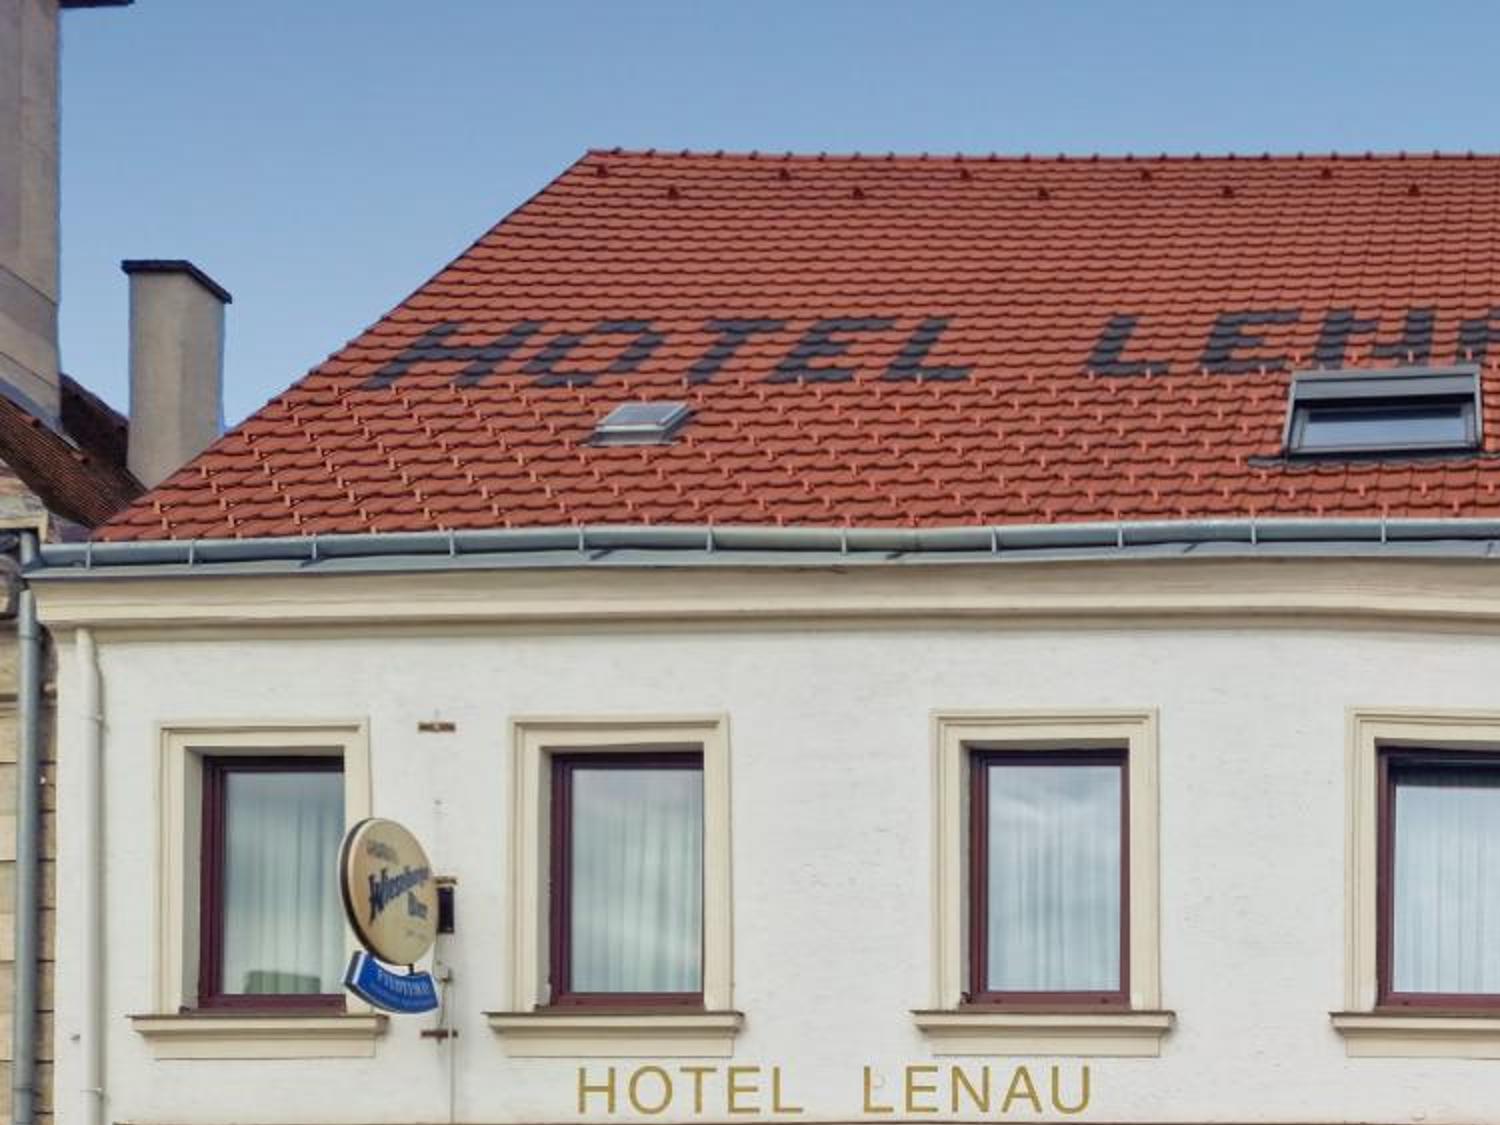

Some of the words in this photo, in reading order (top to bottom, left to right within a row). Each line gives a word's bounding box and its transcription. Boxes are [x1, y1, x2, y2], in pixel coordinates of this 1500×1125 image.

[356, 314, 967, 389] HOTEL
[578, 1065, 803, 1115] HOTEL
[863, 1065, 1091, 1115] LENAU
